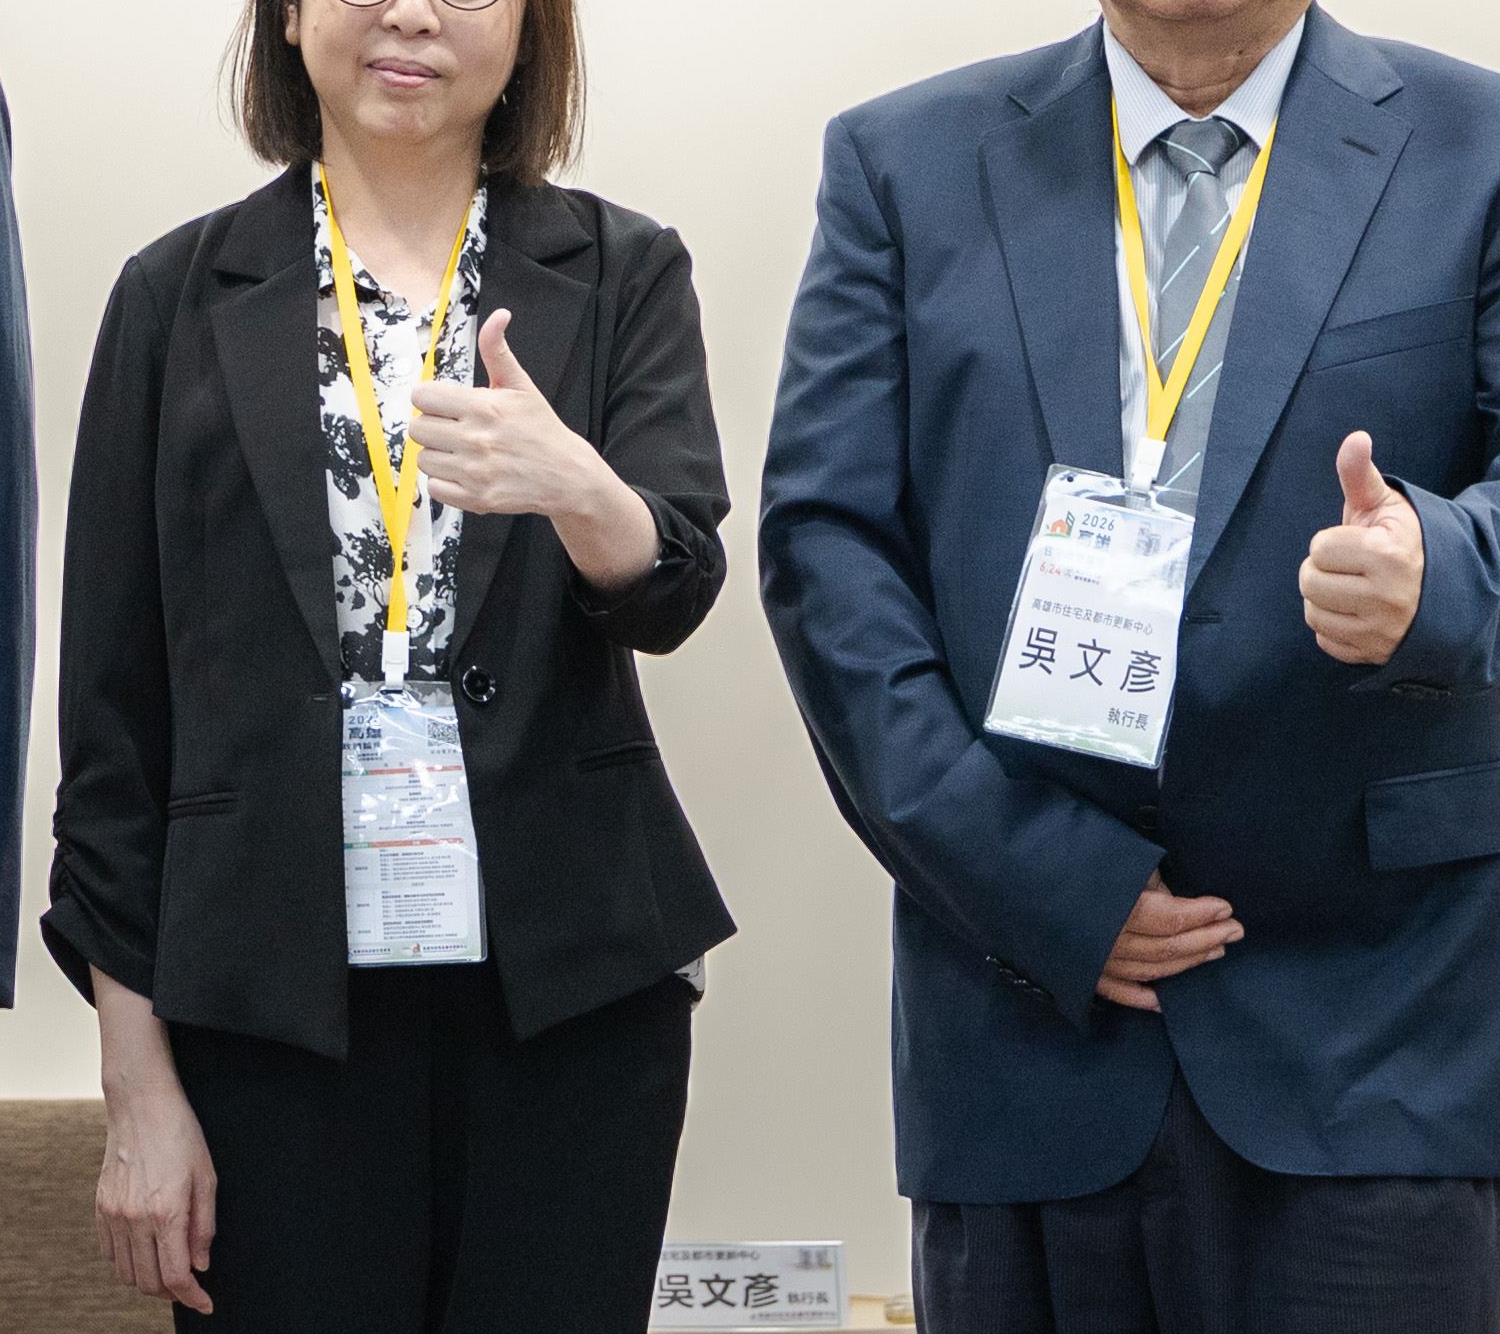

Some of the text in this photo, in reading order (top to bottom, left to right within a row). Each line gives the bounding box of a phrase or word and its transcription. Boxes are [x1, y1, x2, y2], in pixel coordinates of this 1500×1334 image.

[1082, 513, 1115, 531] 2026
[1032, 598, 1153, 636] 高雄市住宅及都市更新中心
[1019, 627, 1162, 693] 吳文彥
[1107, 707, 1149, 731] 執行長
[657, 1272, 780, 1309] 吳文彥
